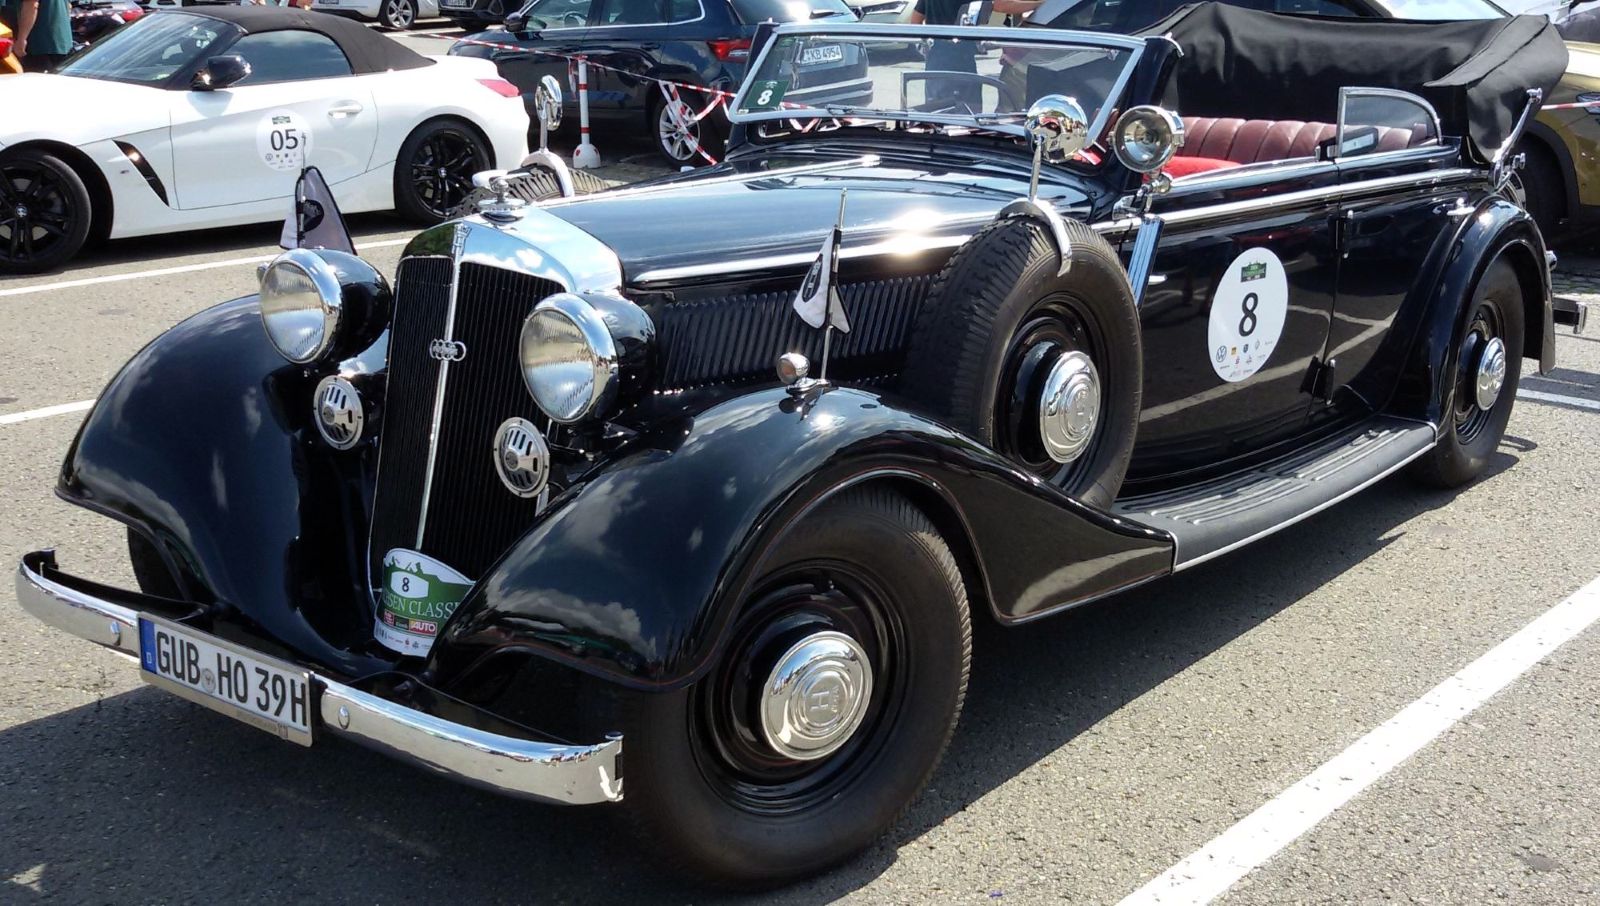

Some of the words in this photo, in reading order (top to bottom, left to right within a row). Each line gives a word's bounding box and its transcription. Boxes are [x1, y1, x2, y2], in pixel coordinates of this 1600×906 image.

[757, 90, 773, 105] 8
[270, 129, 299, 151] 05
[1239, 292, 1259, 337] 8
[402, 577, 410, 592] 8
[157, 631, 200, 685] GUB
[217, 653, 248, 704] HO
[255, 667, 307, 727] 39H
